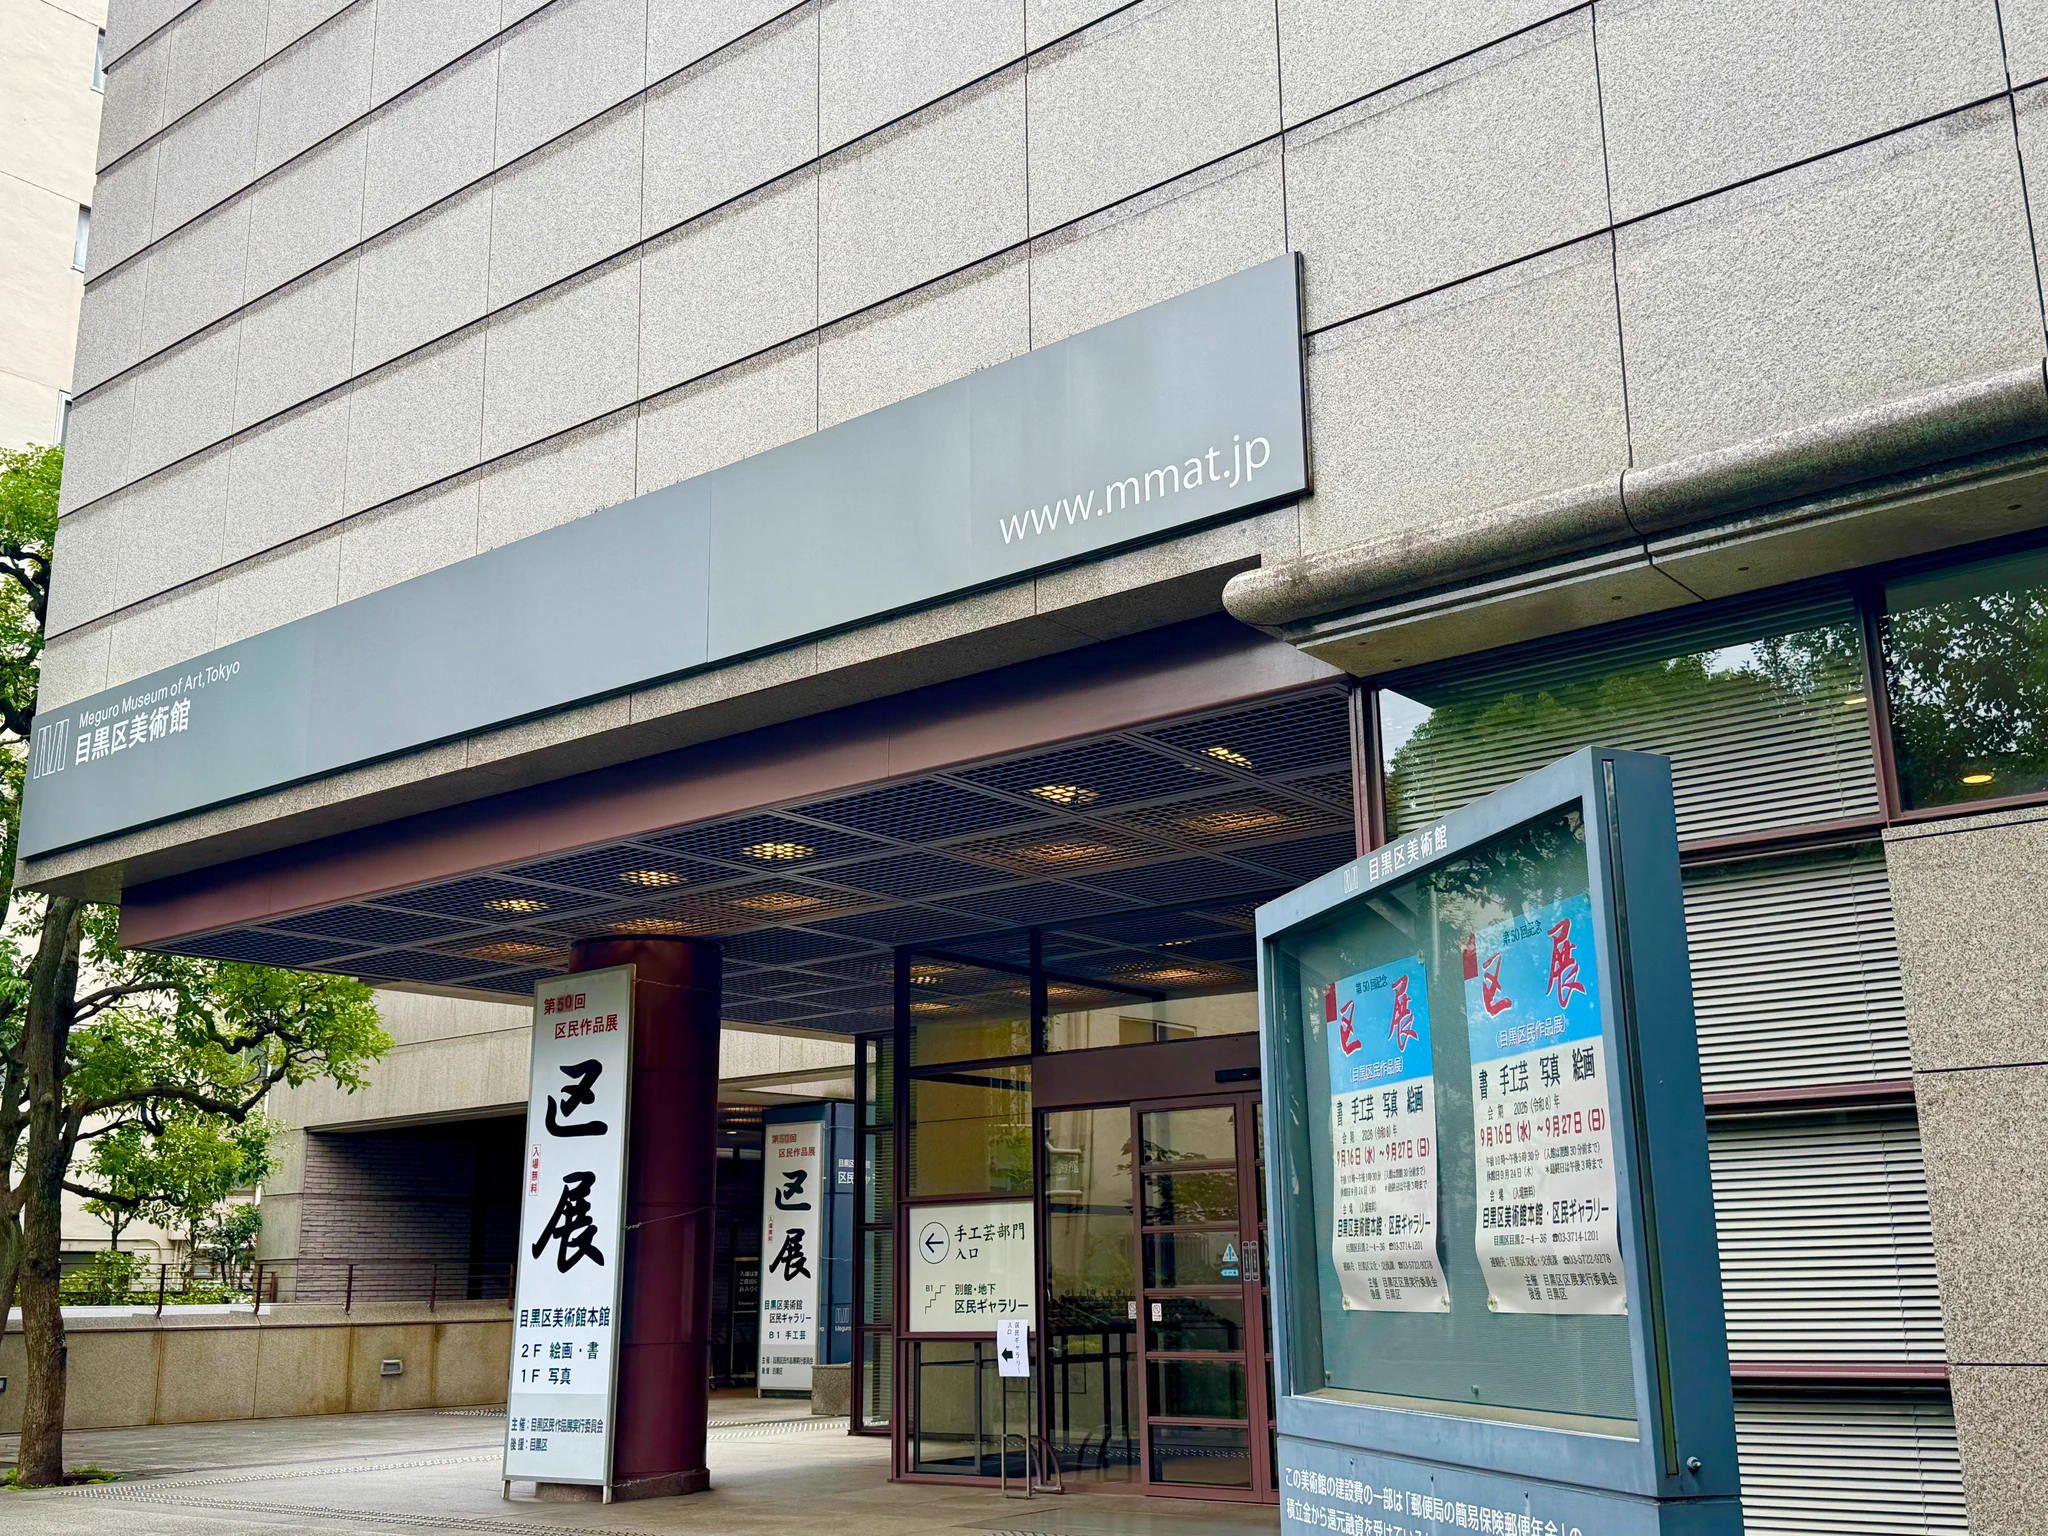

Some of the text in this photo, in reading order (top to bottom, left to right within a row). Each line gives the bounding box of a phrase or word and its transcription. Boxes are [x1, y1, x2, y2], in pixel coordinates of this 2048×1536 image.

[999, 434, 1271, 545] www.mmat.jp
[79, 704, 119, 729] Meguro
[122, 686, 168, 713] Museum
[170, 678, 184, 697] of
[75, 697, 191, 766] 目黒区美術館
[1369, 824, 1448, 883] 目黒区美術館
[1503, 919, 1543, 946] 第50回記念
[1355, 973, 1388, 995] 第50回記念
[544, 993, 586, 1015] 第50回
[555, 1014, 618, 1039] 区民作品展
[1478, 1045, 1596, 1100] 書 手工芸 写真 絵画
[1336, 1084, 1424, 1127] 書 手工芸 写真 絵画
[771, 1133, 797, 1144] 第50回
[778, 1147, 816, 1158] 区民作品展
[530, 1146, 540, 1193] 入場無料
[1482, 1197, 1609, 1229] 目黒区美術館本館・区民ギャラリー
[954, 1222, 1026, 1243] 手工芸部門
[1337, 1213, 1431, 1237] 目黒区美術館本館・区民ギャラリー
[955, 1247, 979, 1260] 入口
[925, 1284, 934, 1292] B1
[954, 1283, 996, 1296] 別館・地下
[1524, 1272, 1619, 1287] 主催 目黒区区展実行委員会
[1546, 1287, 1568, 1300] 目黒区
[764, 1299, 803, 1311] 目黒区美術館
[954, 1298, 1029, 1314] 区民ギャラリー
[519, 1305, 611, 1328] 目黒区美術館本館
[769, 1313, 812, 1324] 区民ギャラリー
[769, 1330, 806, 1340] B1 手工芸
[1006, 1322, 1013, 1335] 入口
[521, 1341, 599, 1360] 2F 絵画・書
[1014, 1321, 1022, 1374] 区民ギャラリー
[521, 1367, 572, 1385] 1F 写真
